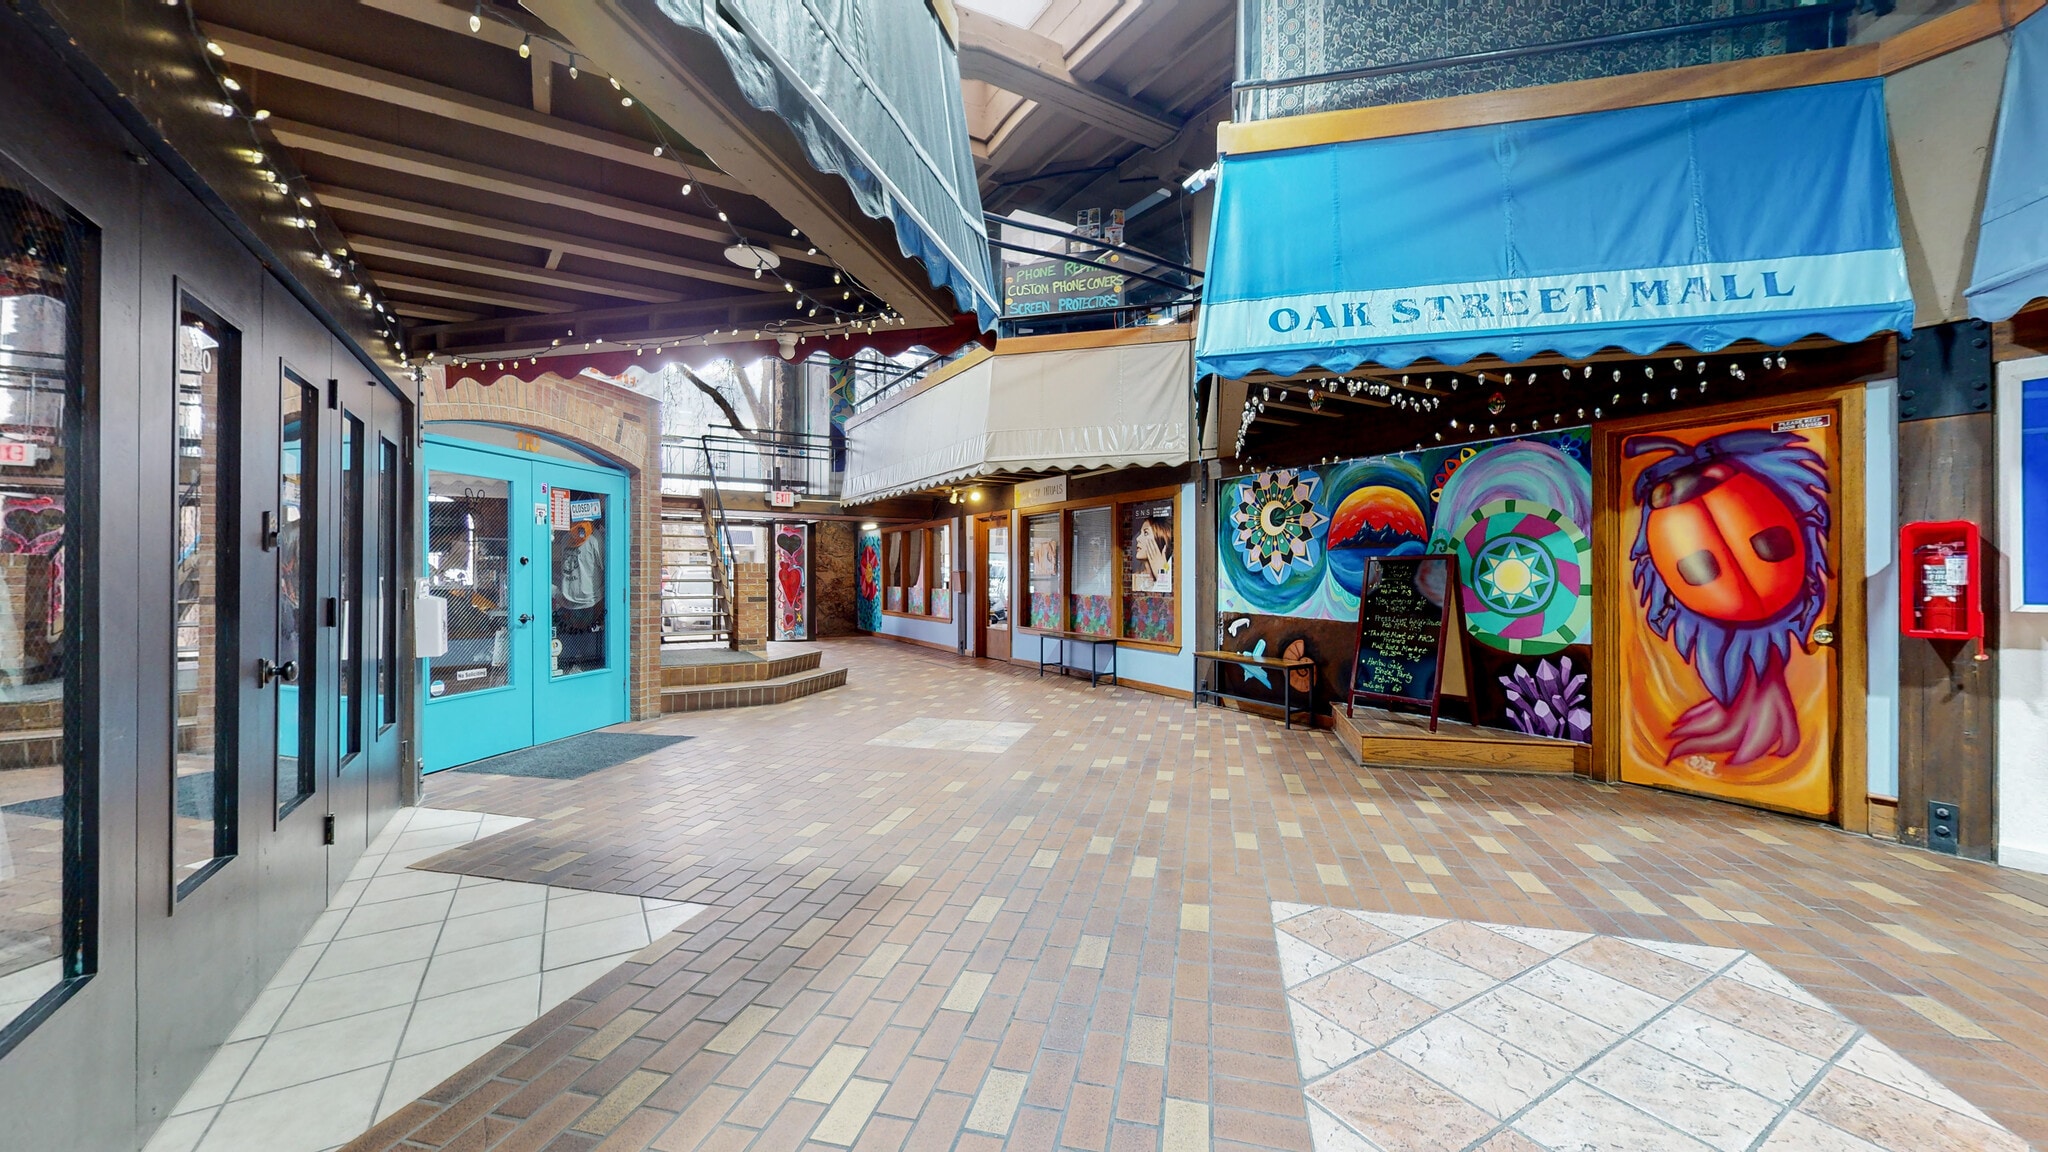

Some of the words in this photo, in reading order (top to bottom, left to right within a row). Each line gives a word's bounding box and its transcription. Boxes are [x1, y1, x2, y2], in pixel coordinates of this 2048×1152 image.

[1016, 265, 1056, 282] PHONE
[1008, 283, 1049, 296] CUSTOM
[1053, 279, 1086, 293] PHONE
[1087, 275, 1124, 290] COVERS
[1009, 301, 1050, 315] SCREEN
[1058, 294, 1118, 311] PROTECTORS
[1268, 302, 1375, 333] OAK
[1392, 284, 1608, 324] STREET
[1630, 271, 1796, 308] MALL
[1778, 419, 1802, 427] PLEASE
[514, 431, 541, 452] 110
[776, 491, 791, 504] EXIT
[572, 503, 591, 514] CLOSED
[1135, 508, 1151, 517] SNS
